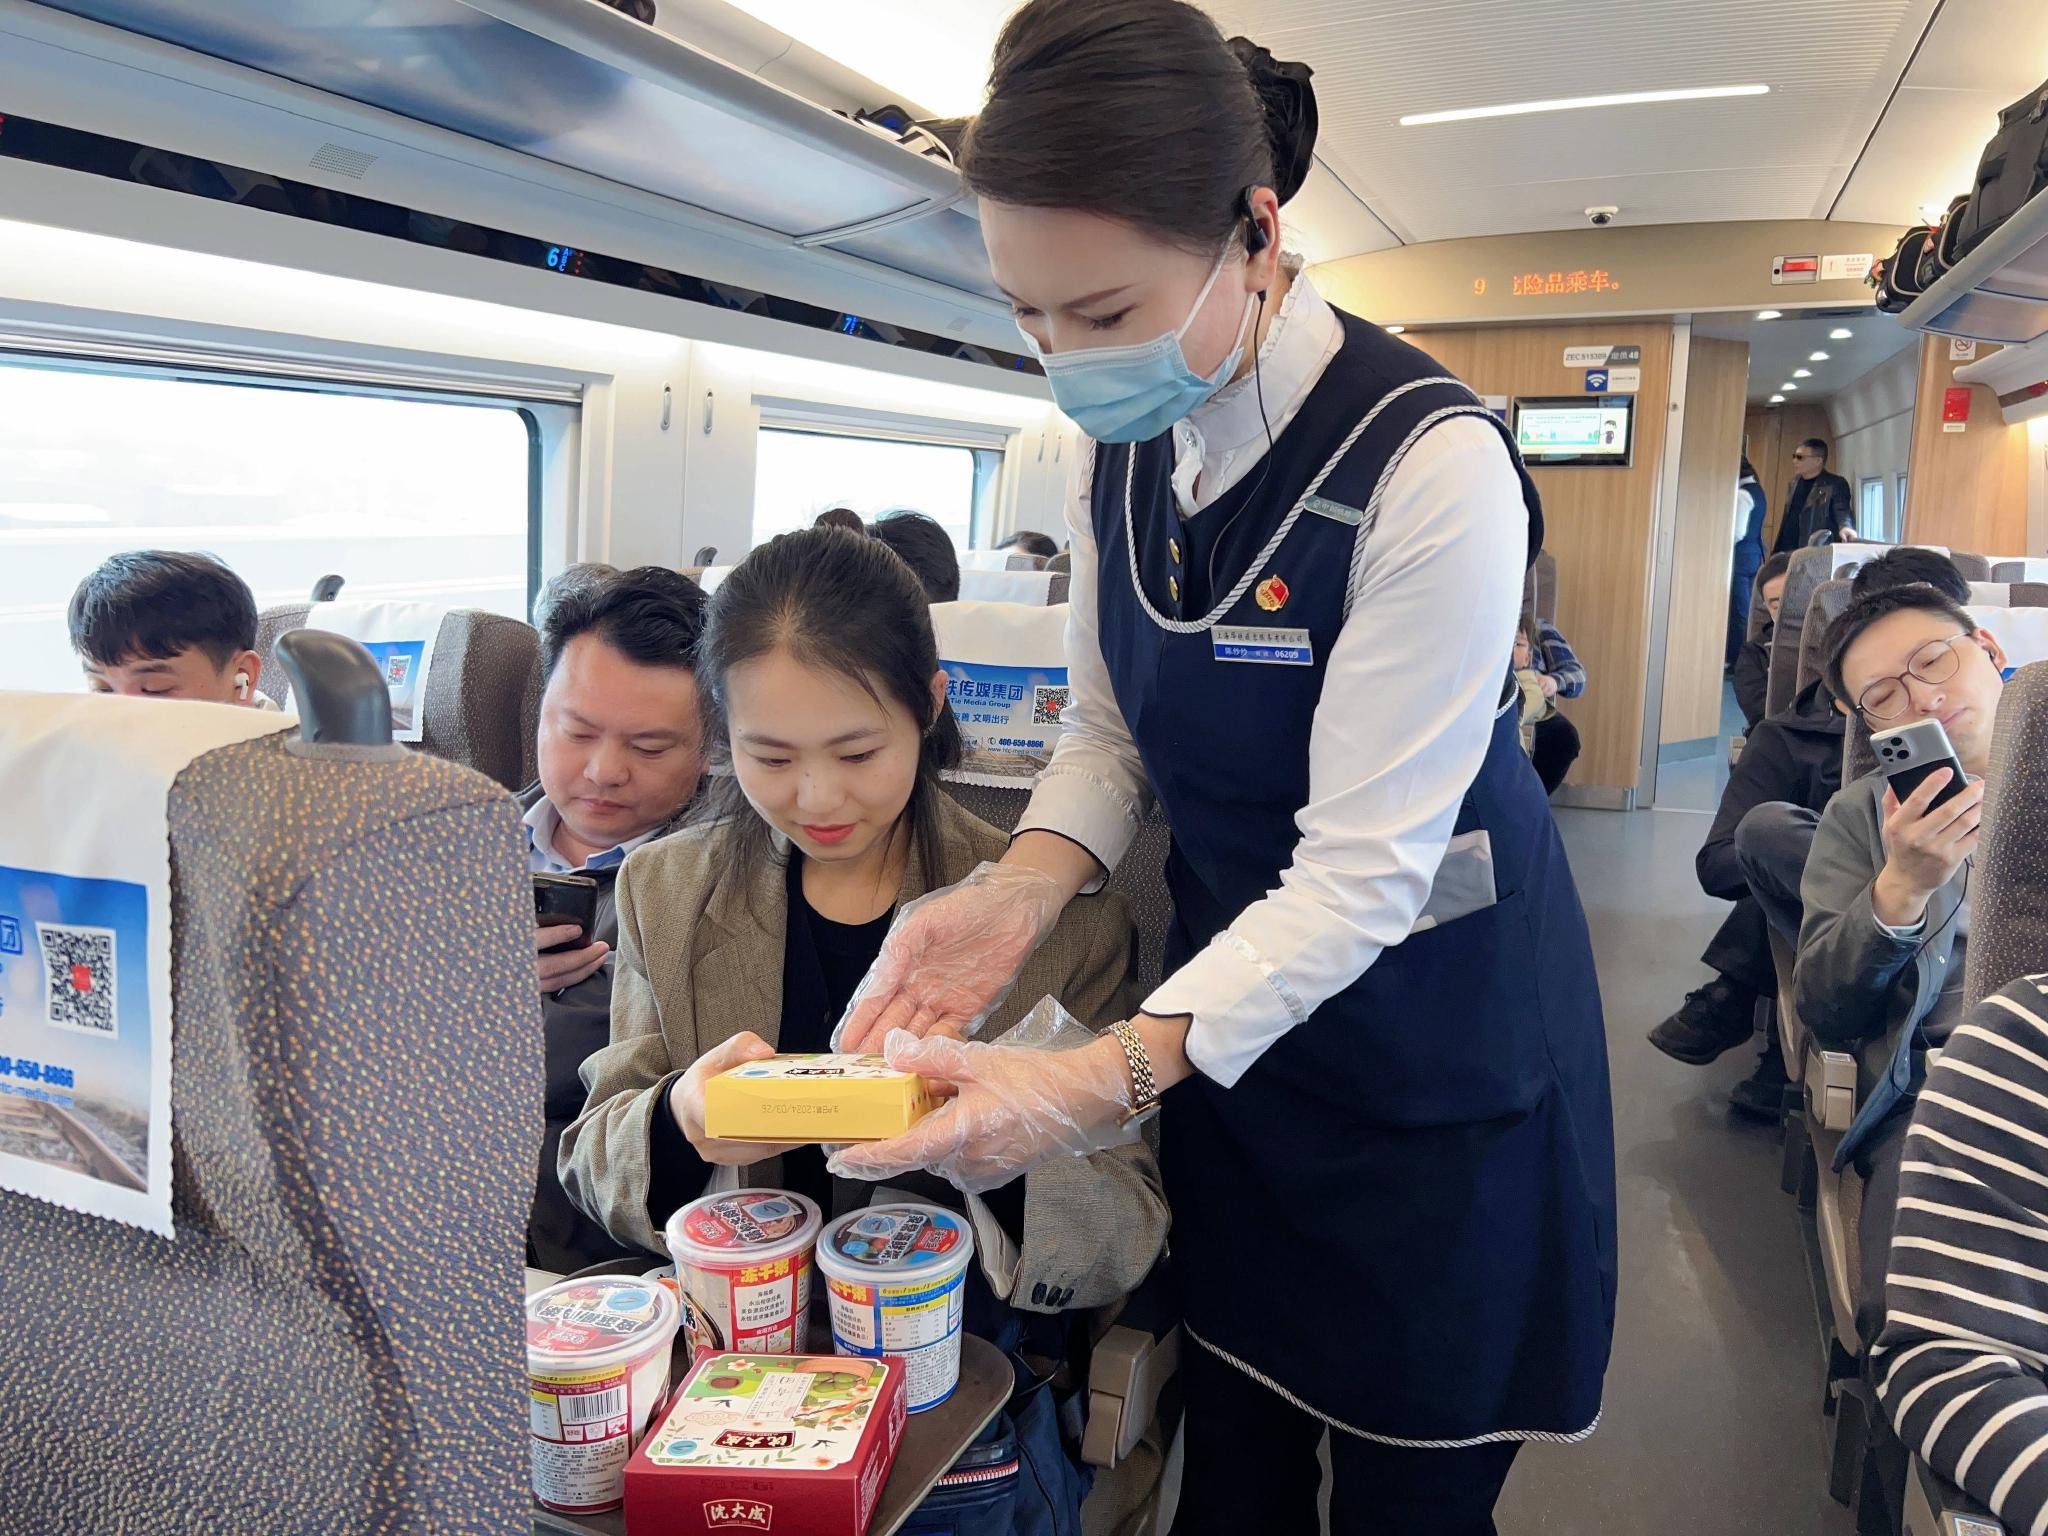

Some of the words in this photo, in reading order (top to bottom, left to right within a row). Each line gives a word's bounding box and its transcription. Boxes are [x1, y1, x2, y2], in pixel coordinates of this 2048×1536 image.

[547, 247, 560, 267] 6
[1473, 277, 1487, 296] 9
[964, 698, 987, 706] Media
[989, 701, 1011, 709] Group
[972, 713, 1009, 724] 文明出行
[721, 1433, 787, 1448] 沈大成
[710, 1502, 766, 1524] 沈大成
